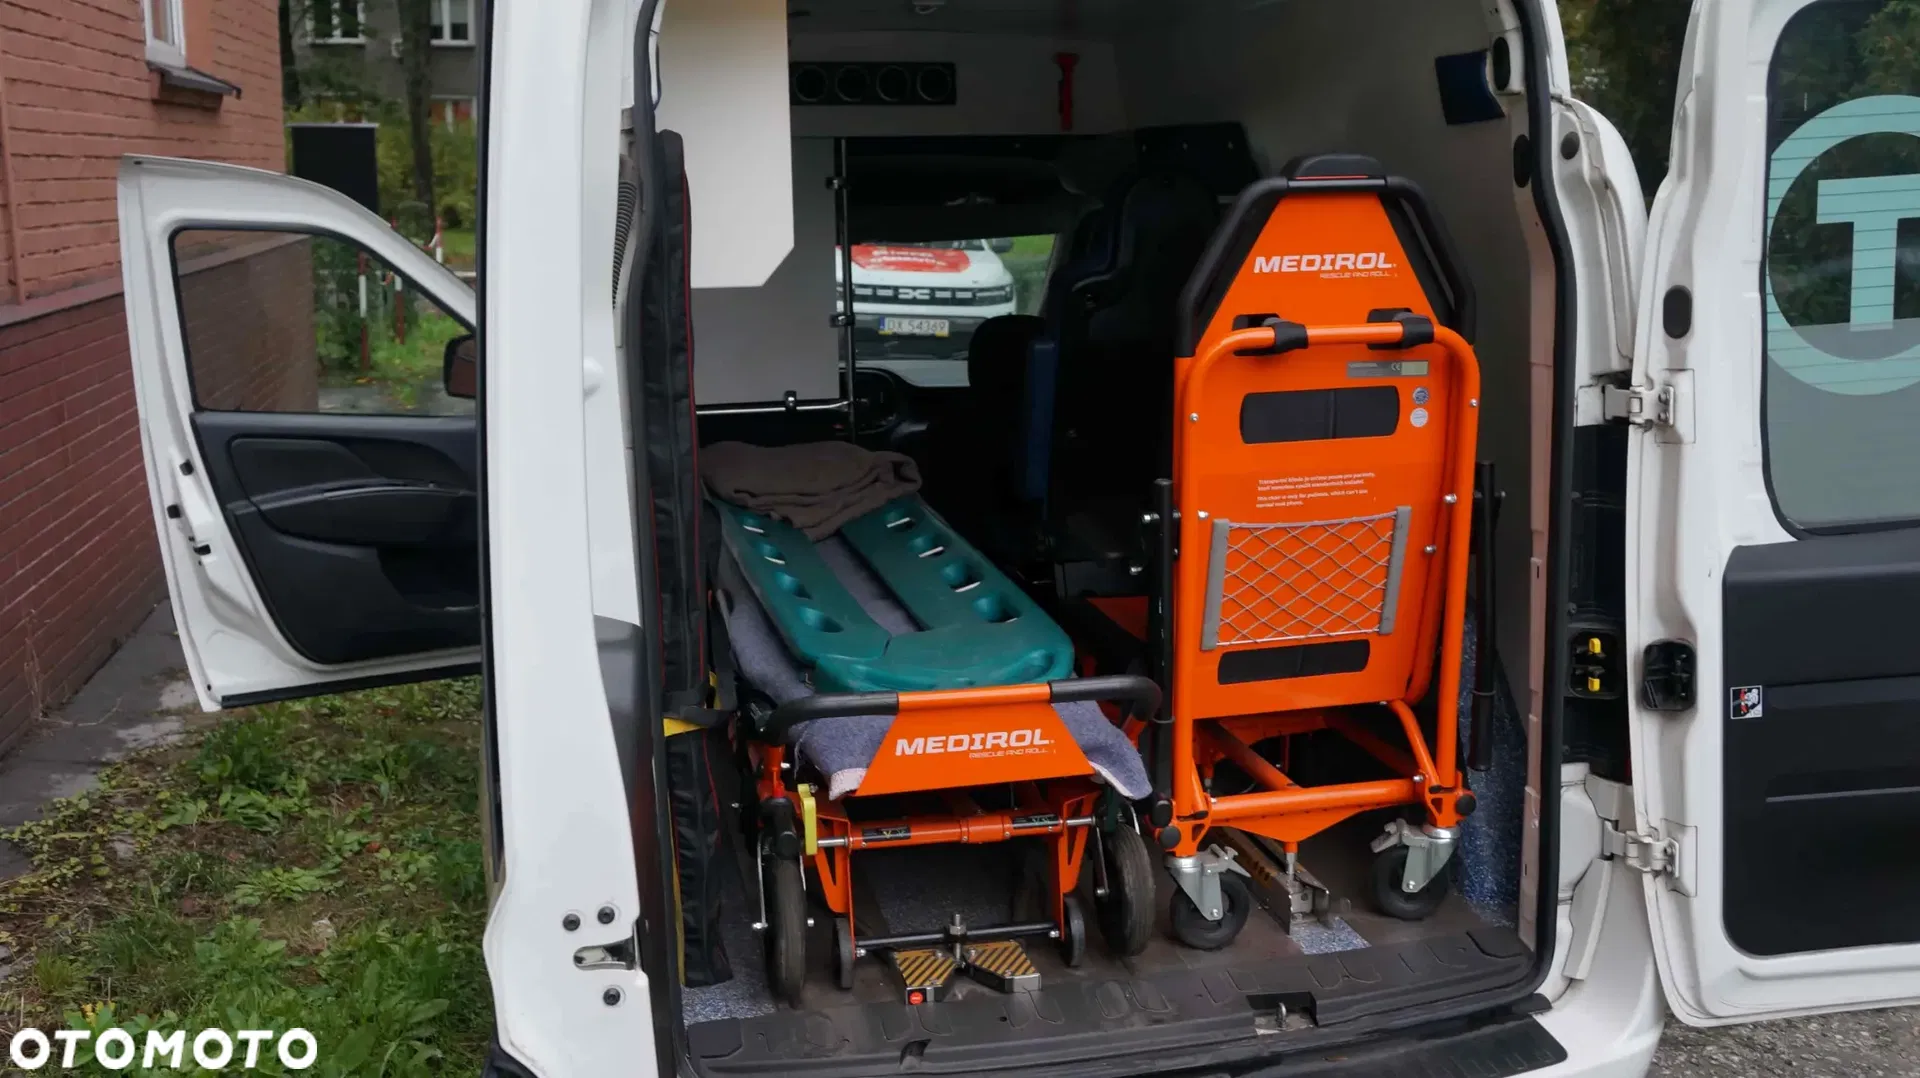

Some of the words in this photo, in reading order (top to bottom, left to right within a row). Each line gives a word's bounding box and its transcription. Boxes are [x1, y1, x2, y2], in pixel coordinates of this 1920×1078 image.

[1253, 252, 1393, 274] MEDIROL
[895, 728, 1050, 757] MEDIROL
[969, 750, 1005, 759] RESCUE
[1005, 748, 1025, 756] AND
[1025, 746, 1049, 755] ROLL
